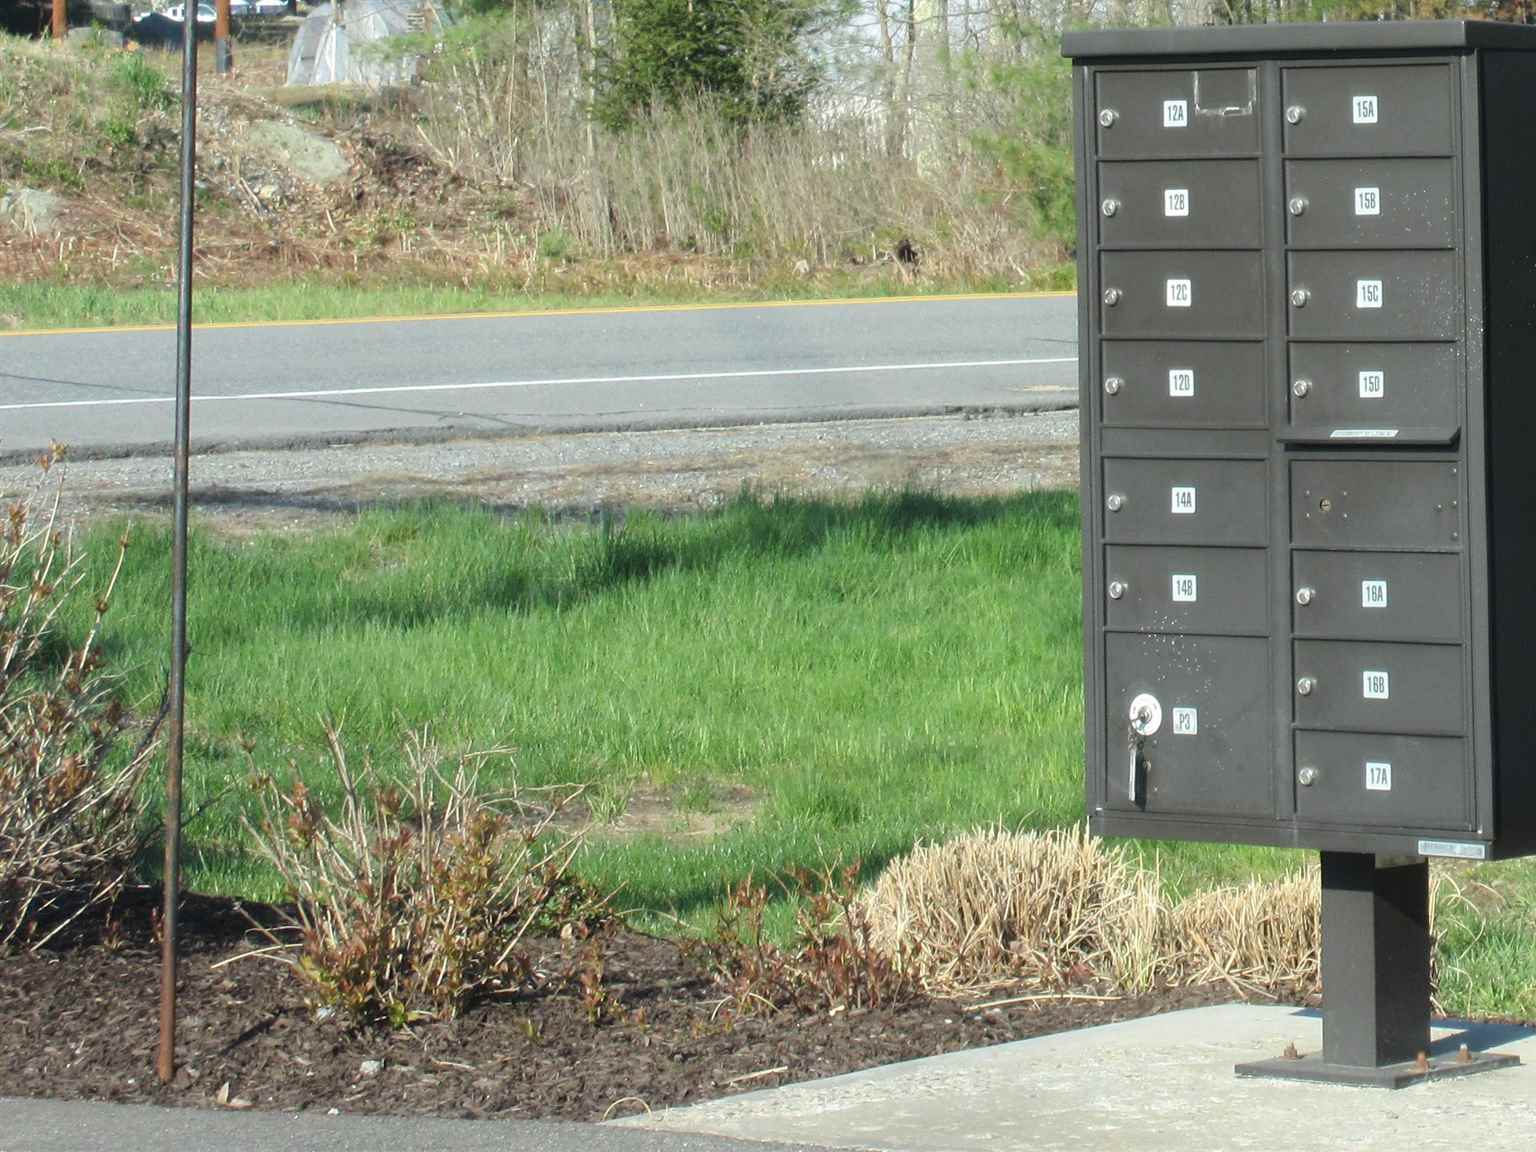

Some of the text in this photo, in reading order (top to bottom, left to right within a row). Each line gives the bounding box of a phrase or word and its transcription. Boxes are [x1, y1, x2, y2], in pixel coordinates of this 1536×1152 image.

[1168, 105, 1184, 121] 12A
[1358, 100, 1374, 118] 15A
[1169, 194, 1185, 210] 12B
[1359, 192, 1376, 209] 15B
[1171, 284, 1188, 301] 12C
[1362, 285, 1378, 302] 15C
[1176, 492, 1192, 507] 14A
[1177, 579, 1193, 596] 14B
[1370, 767, 1388, 784] 17A
